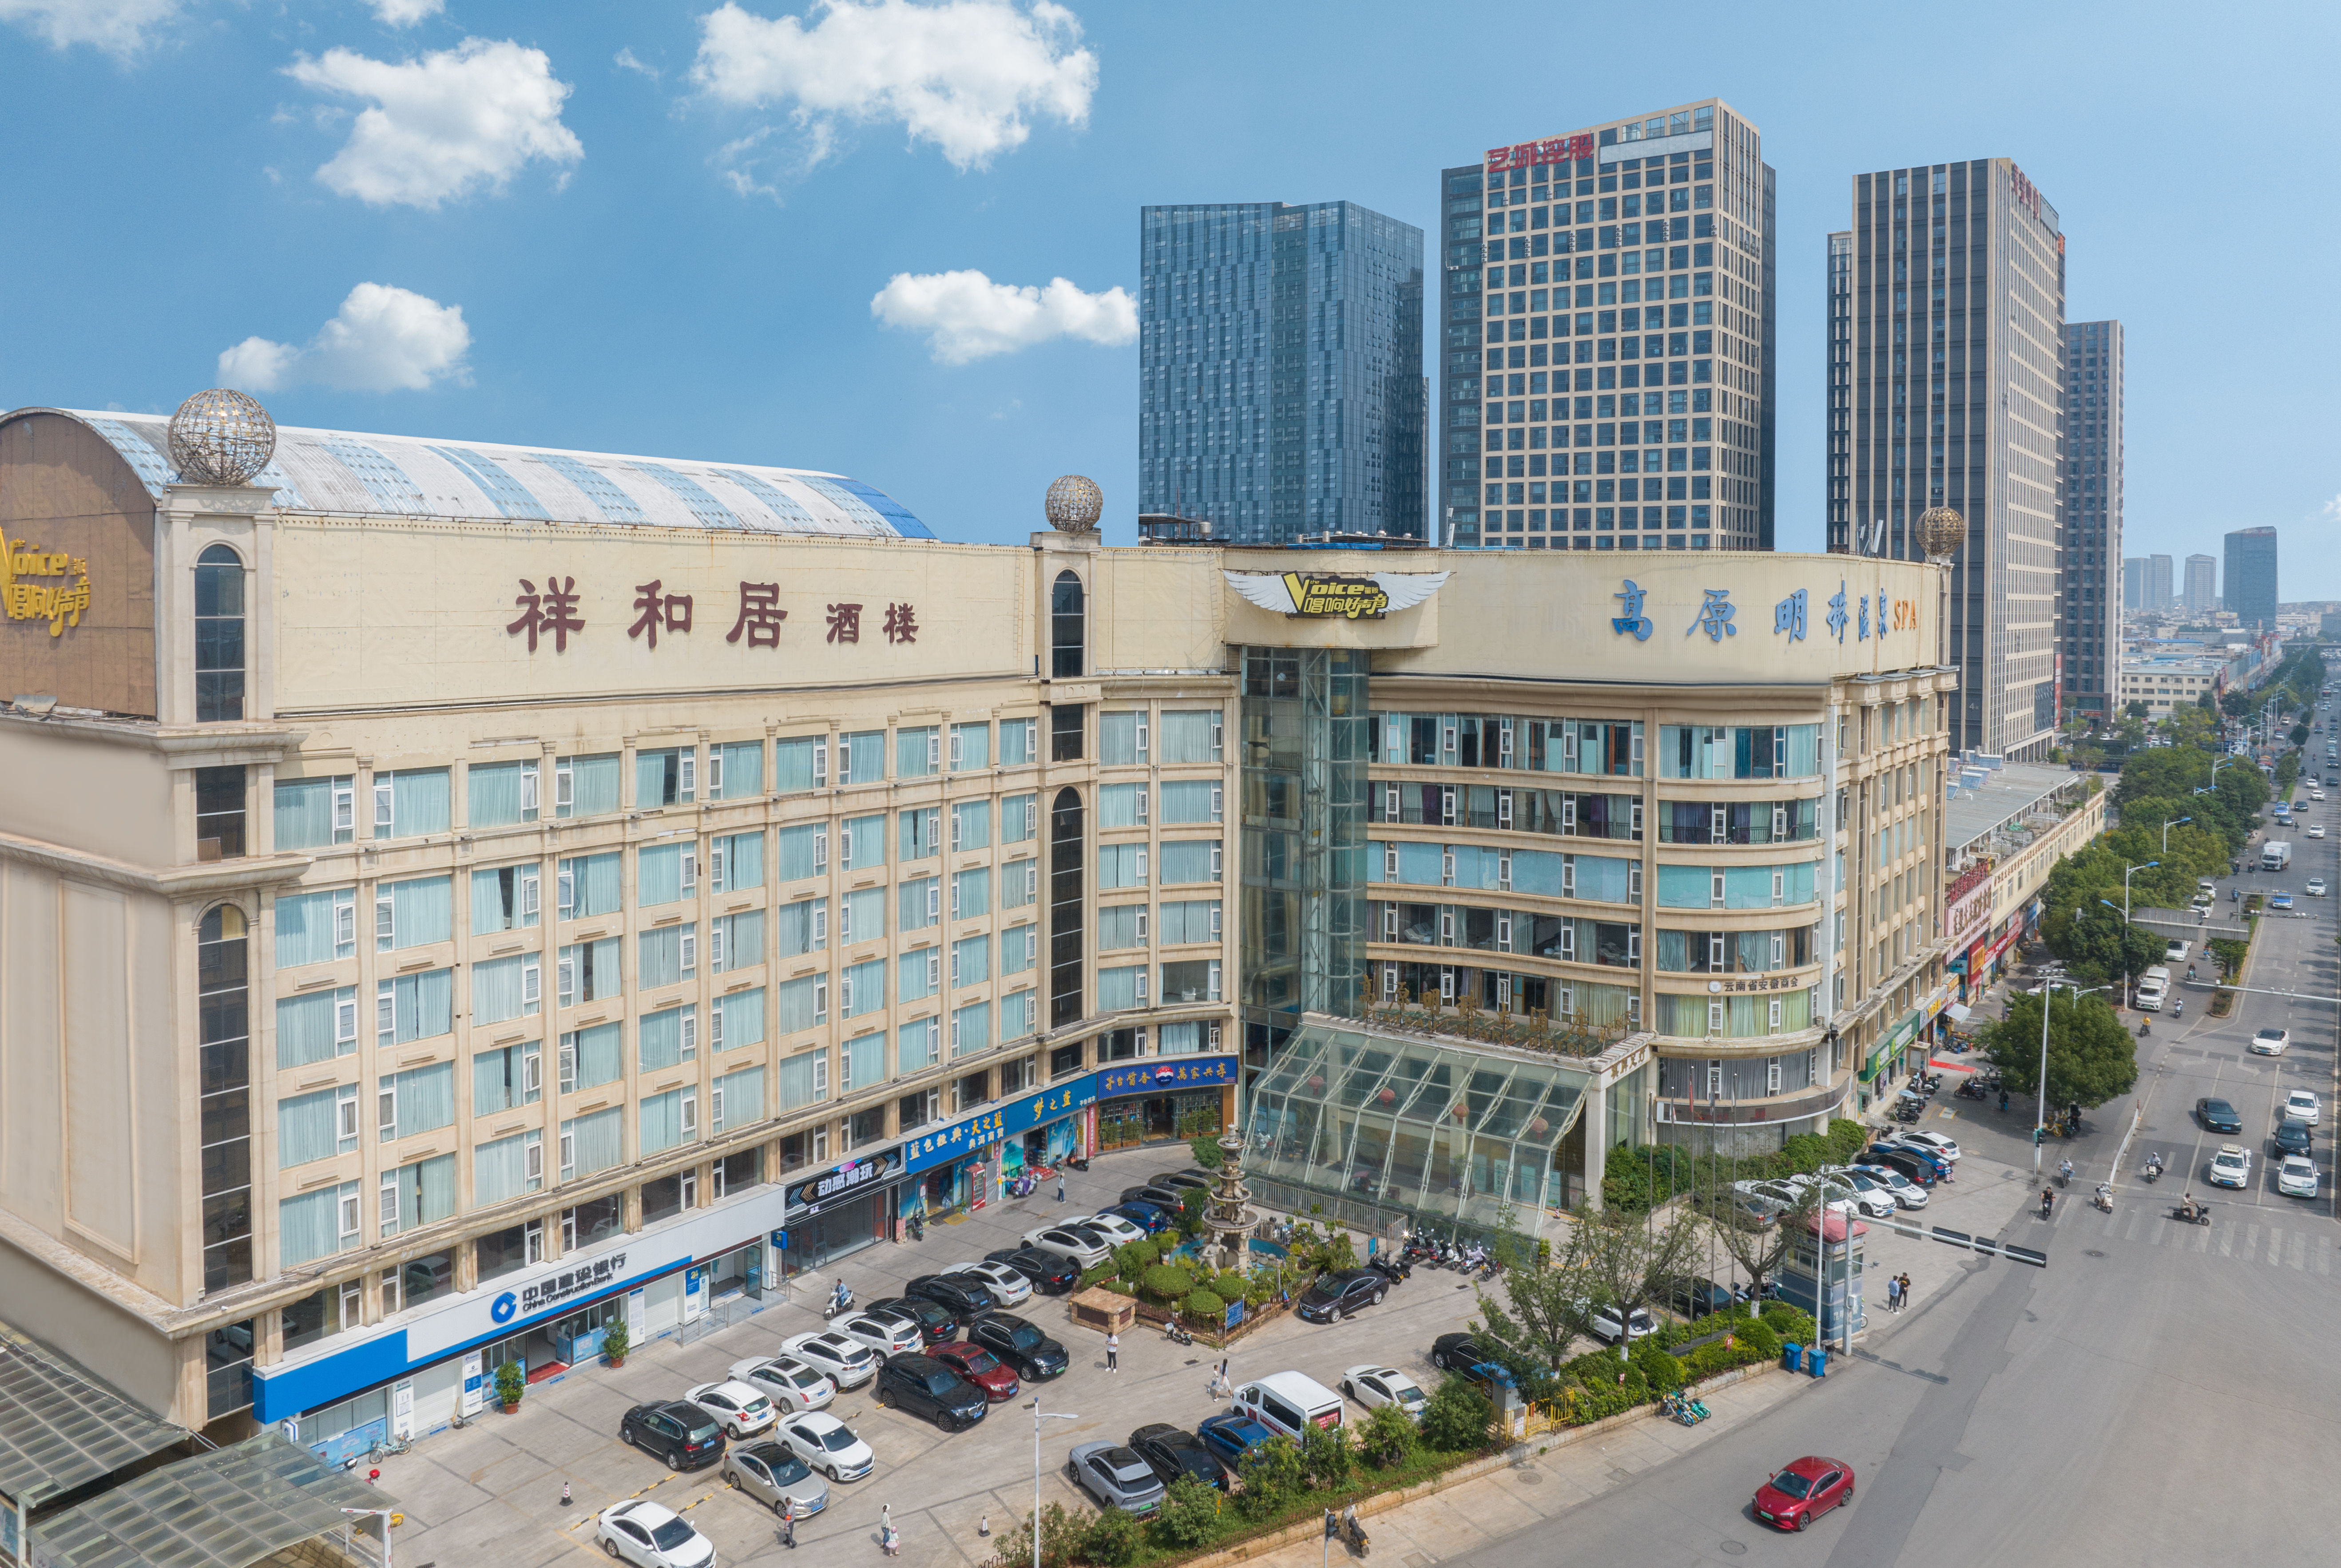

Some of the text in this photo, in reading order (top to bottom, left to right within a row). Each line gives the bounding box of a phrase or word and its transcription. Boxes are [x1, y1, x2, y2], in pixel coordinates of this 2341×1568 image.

[1303, 594, 1387, 619] 唱响好声音
[1724, 976, 1798, 992] 云南省安徽商会
[1359, 974, 1589, 1041] 高原明珠大酒店
[1362, 1009, 1437, 1030] PLATEAU
[818, 1163, 873, 1197] 动感潮玩
[523, 1252, 627, 1301] 中国建设银行
